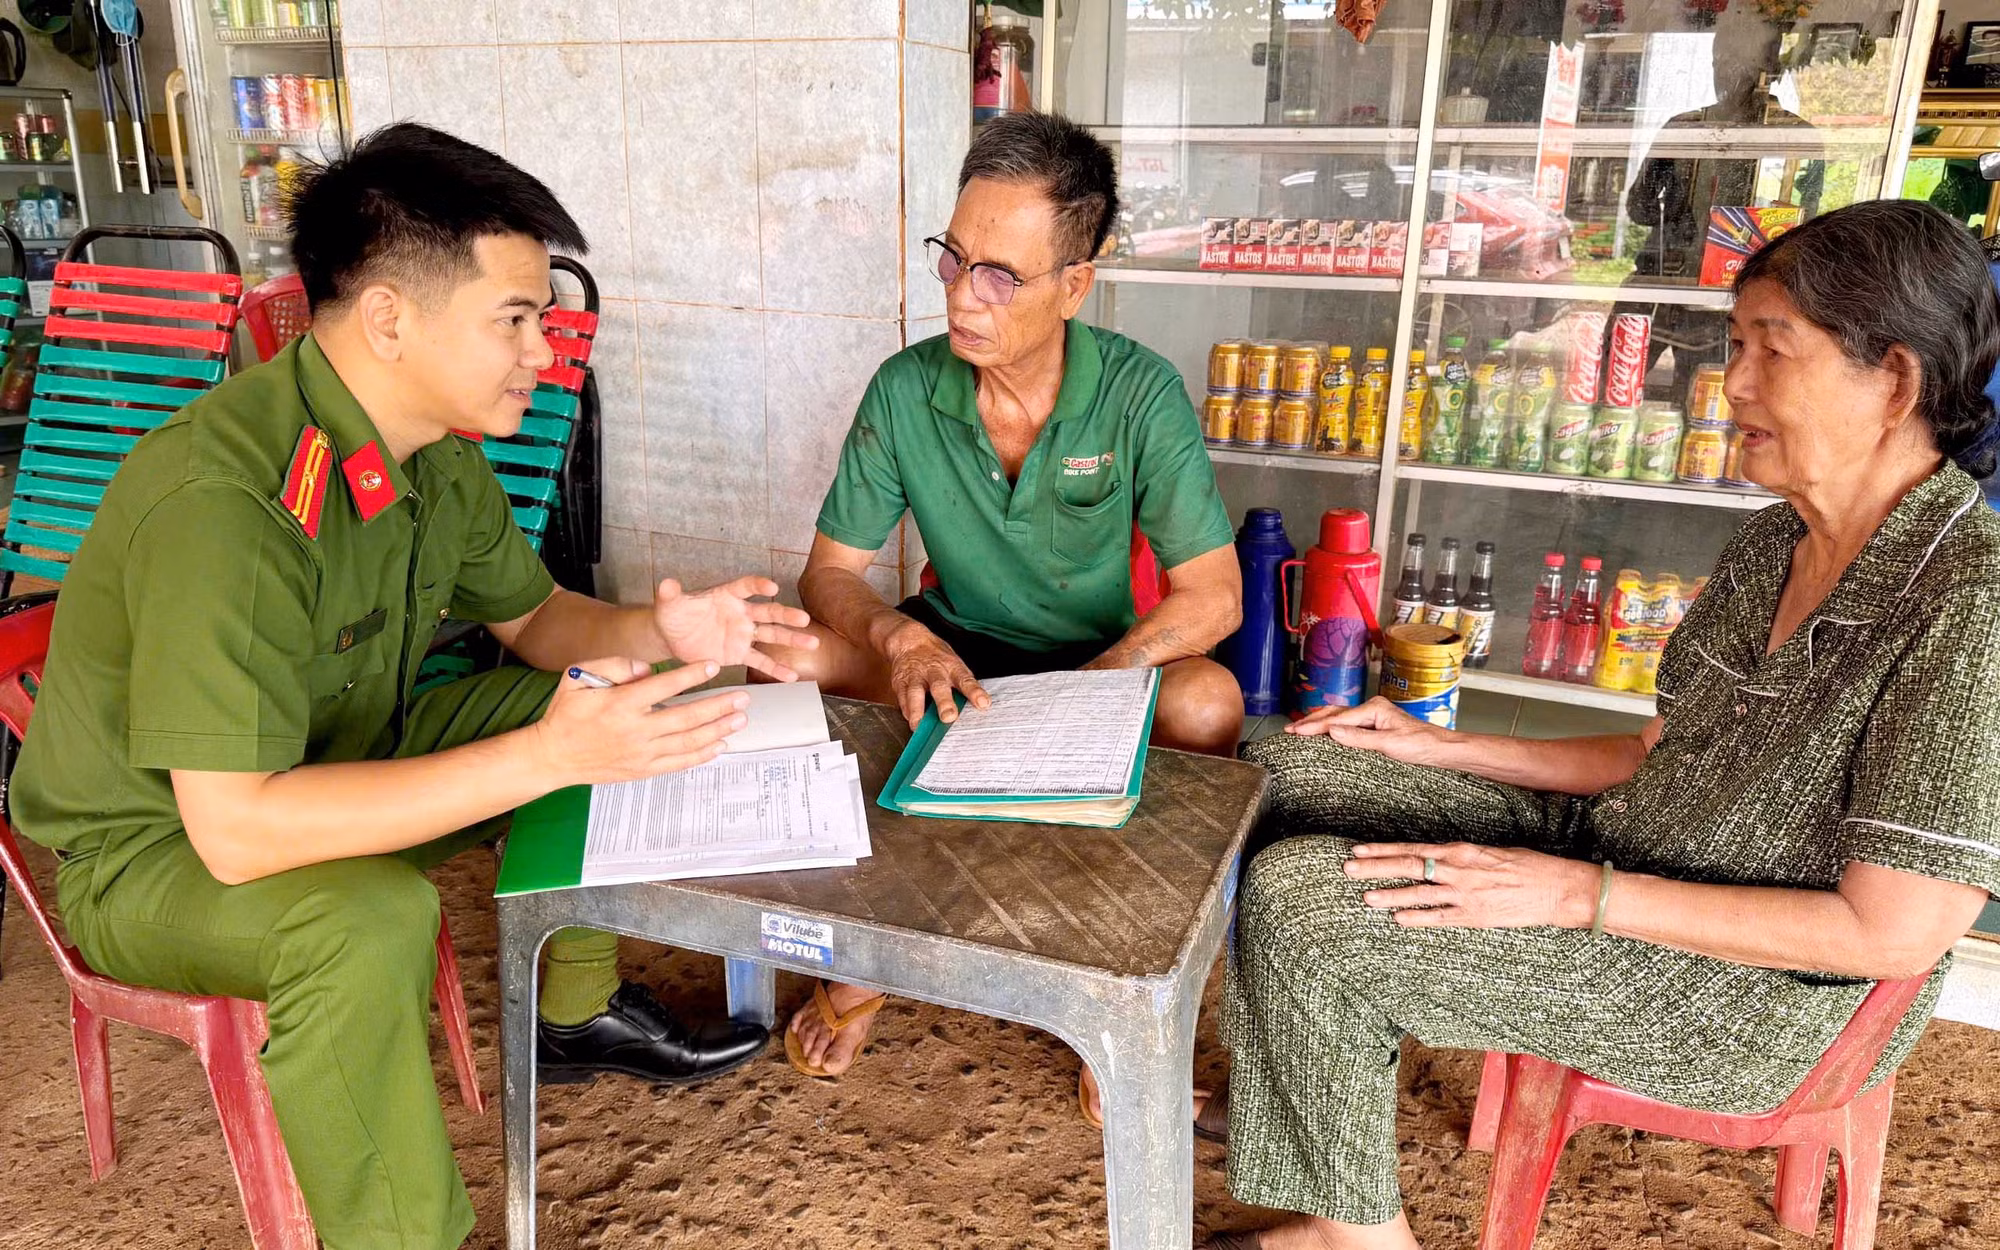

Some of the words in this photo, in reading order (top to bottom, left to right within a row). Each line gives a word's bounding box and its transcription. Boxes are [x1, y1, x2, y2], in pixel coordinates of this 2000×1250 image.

[1234, 251, 1262, 265] BASTOS
[783, 922, 823, 939] Vilube
[767, 938, 823, 960] MOTUL
